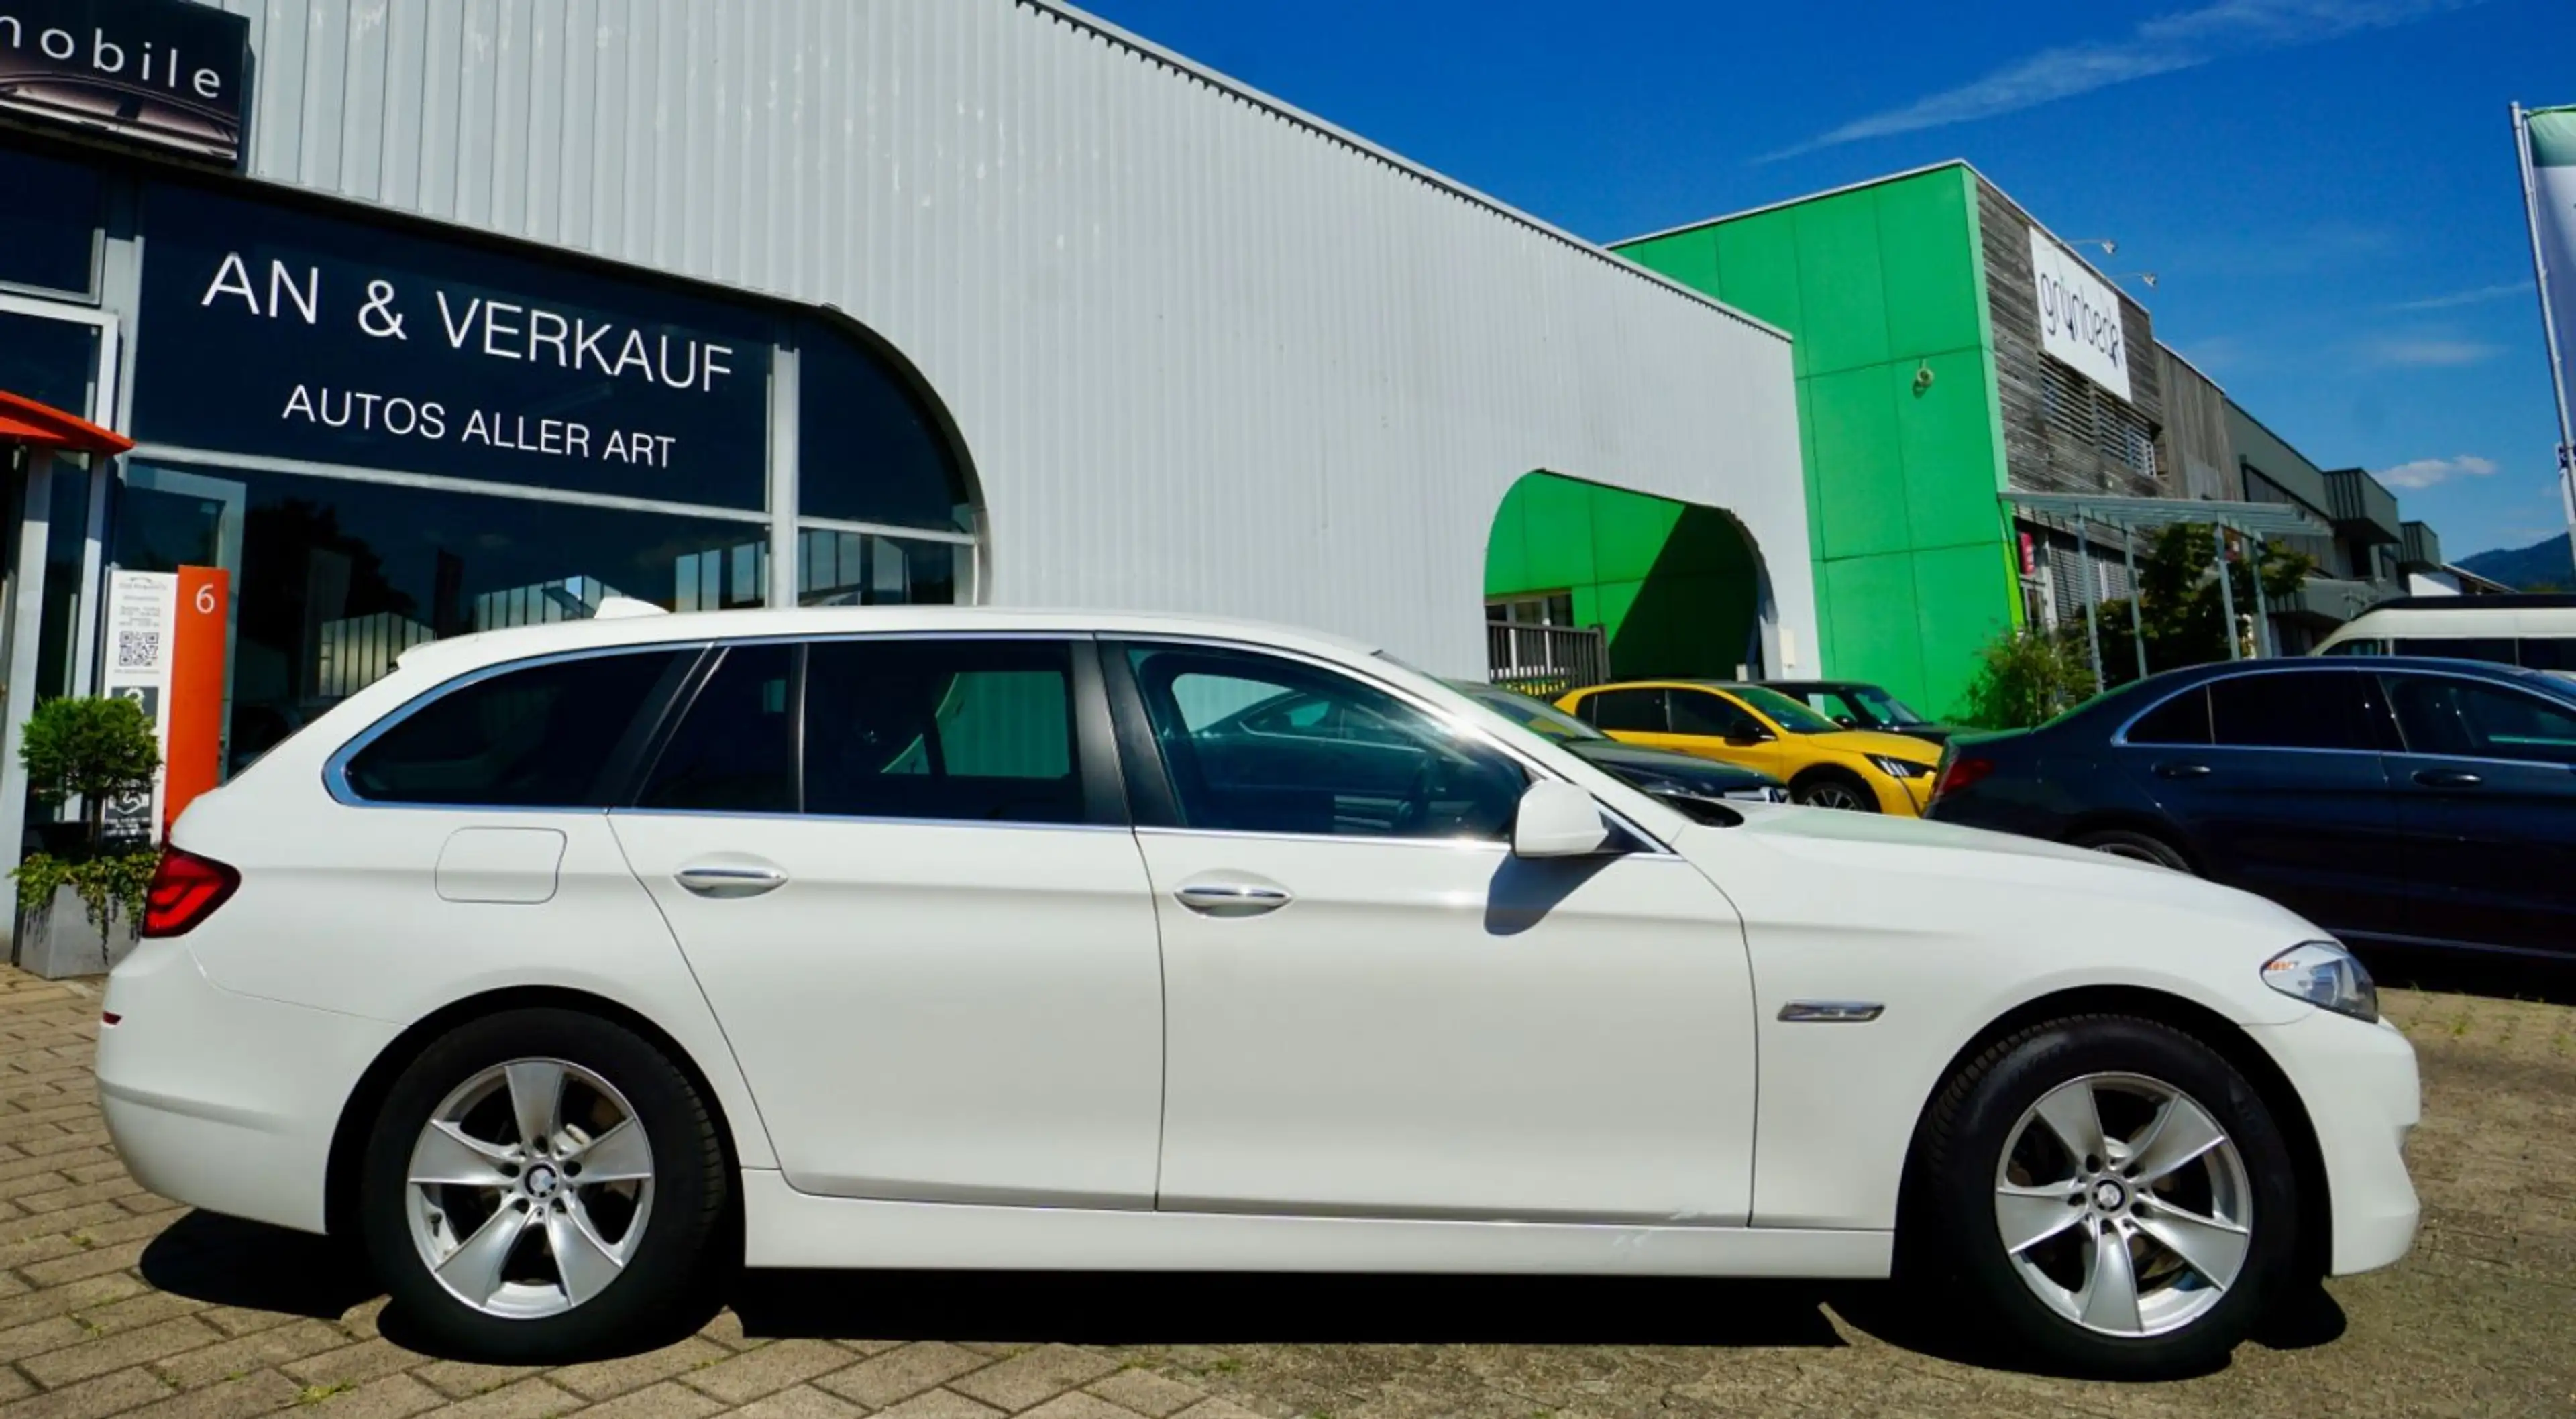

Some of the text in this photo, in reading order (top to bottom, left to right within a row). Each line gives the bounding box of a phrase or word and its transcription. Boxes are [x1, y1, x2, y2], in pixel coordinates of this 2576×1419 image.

[201, 253, 733, 392] AN & VERKAUF
[282, 384, 676, 469] AUTOS ALLER ART
[195, 583, 215, 614] 6
